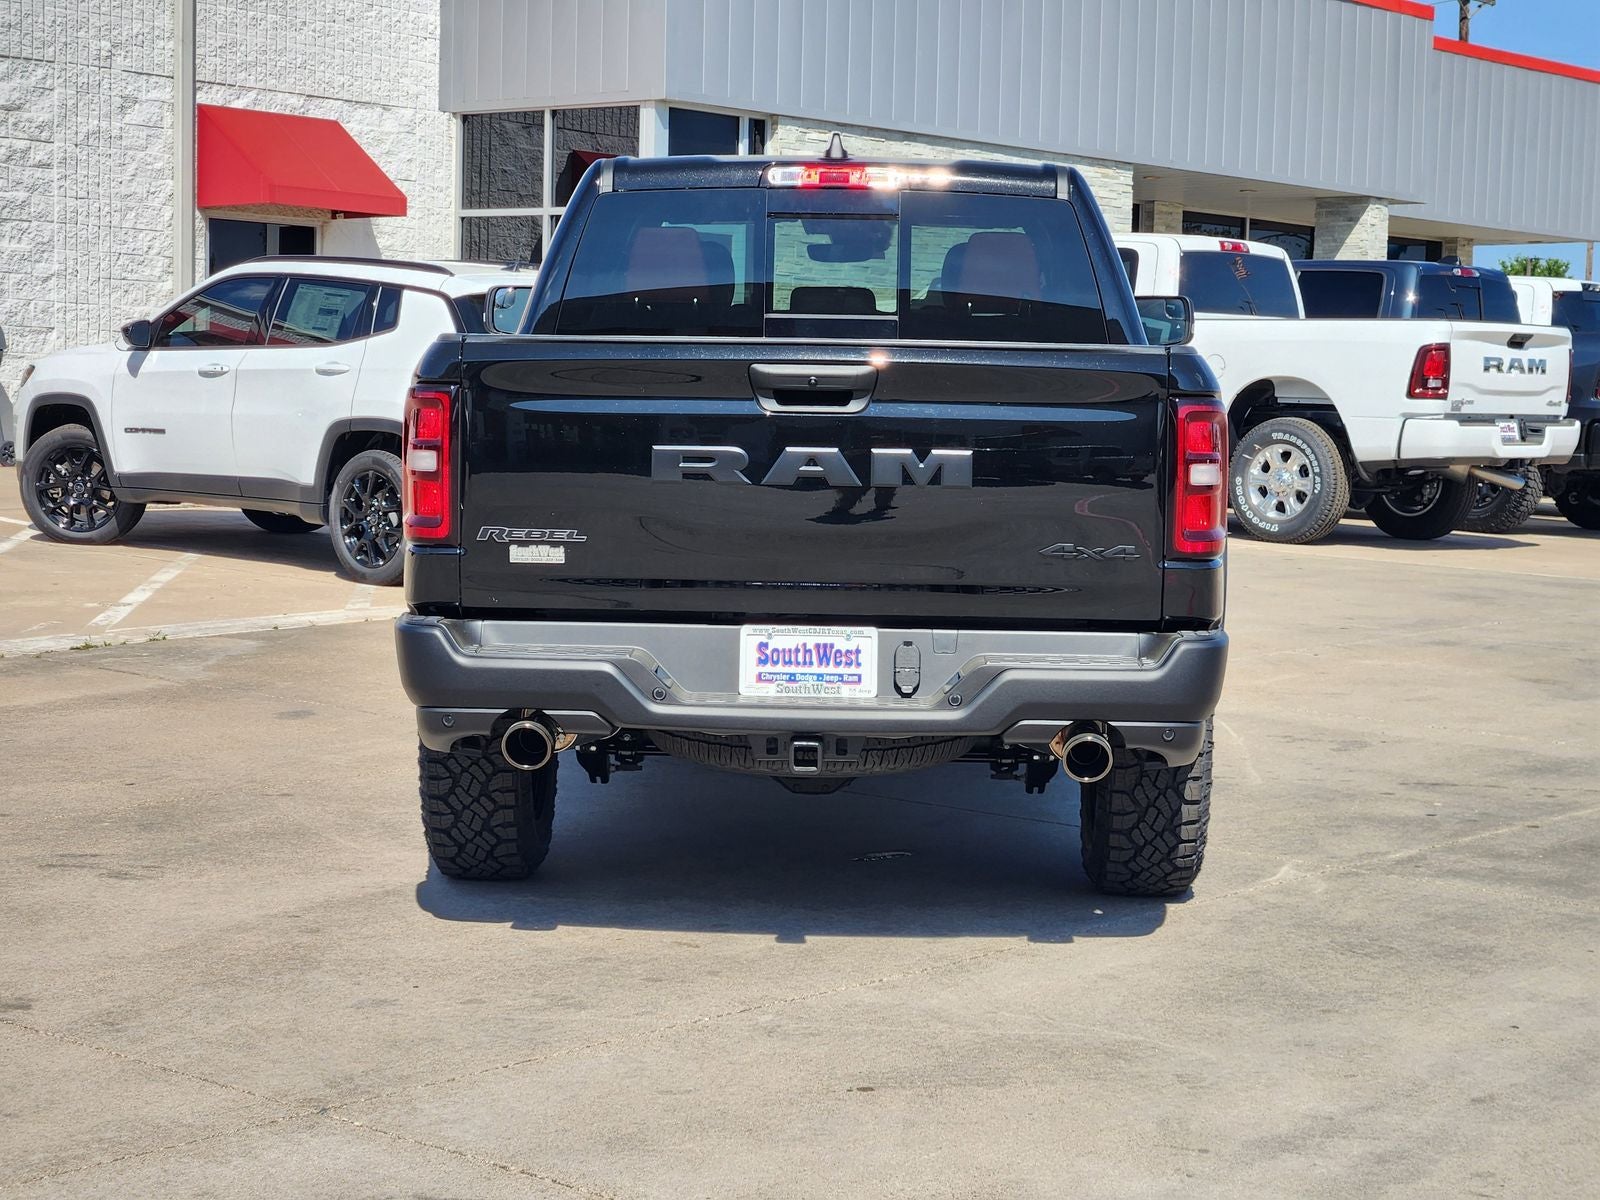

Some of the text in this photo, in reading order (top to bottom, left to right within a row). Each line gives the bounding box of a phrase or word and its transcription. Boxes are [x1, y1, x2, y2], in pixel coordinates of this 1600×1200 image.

[1483, 356, 1548, 375] RAM
[651, 445, 974, 488] RAM
[476, 526, 588, 542] REBEL
[1038, 543, 1141, 560] 4x4
[756, 641, 862, 668] SouthWest
[761, 673, 859, 683] Chrysler Dodge Jeep Ram
[776, 684, 842, 695] SouthWest
